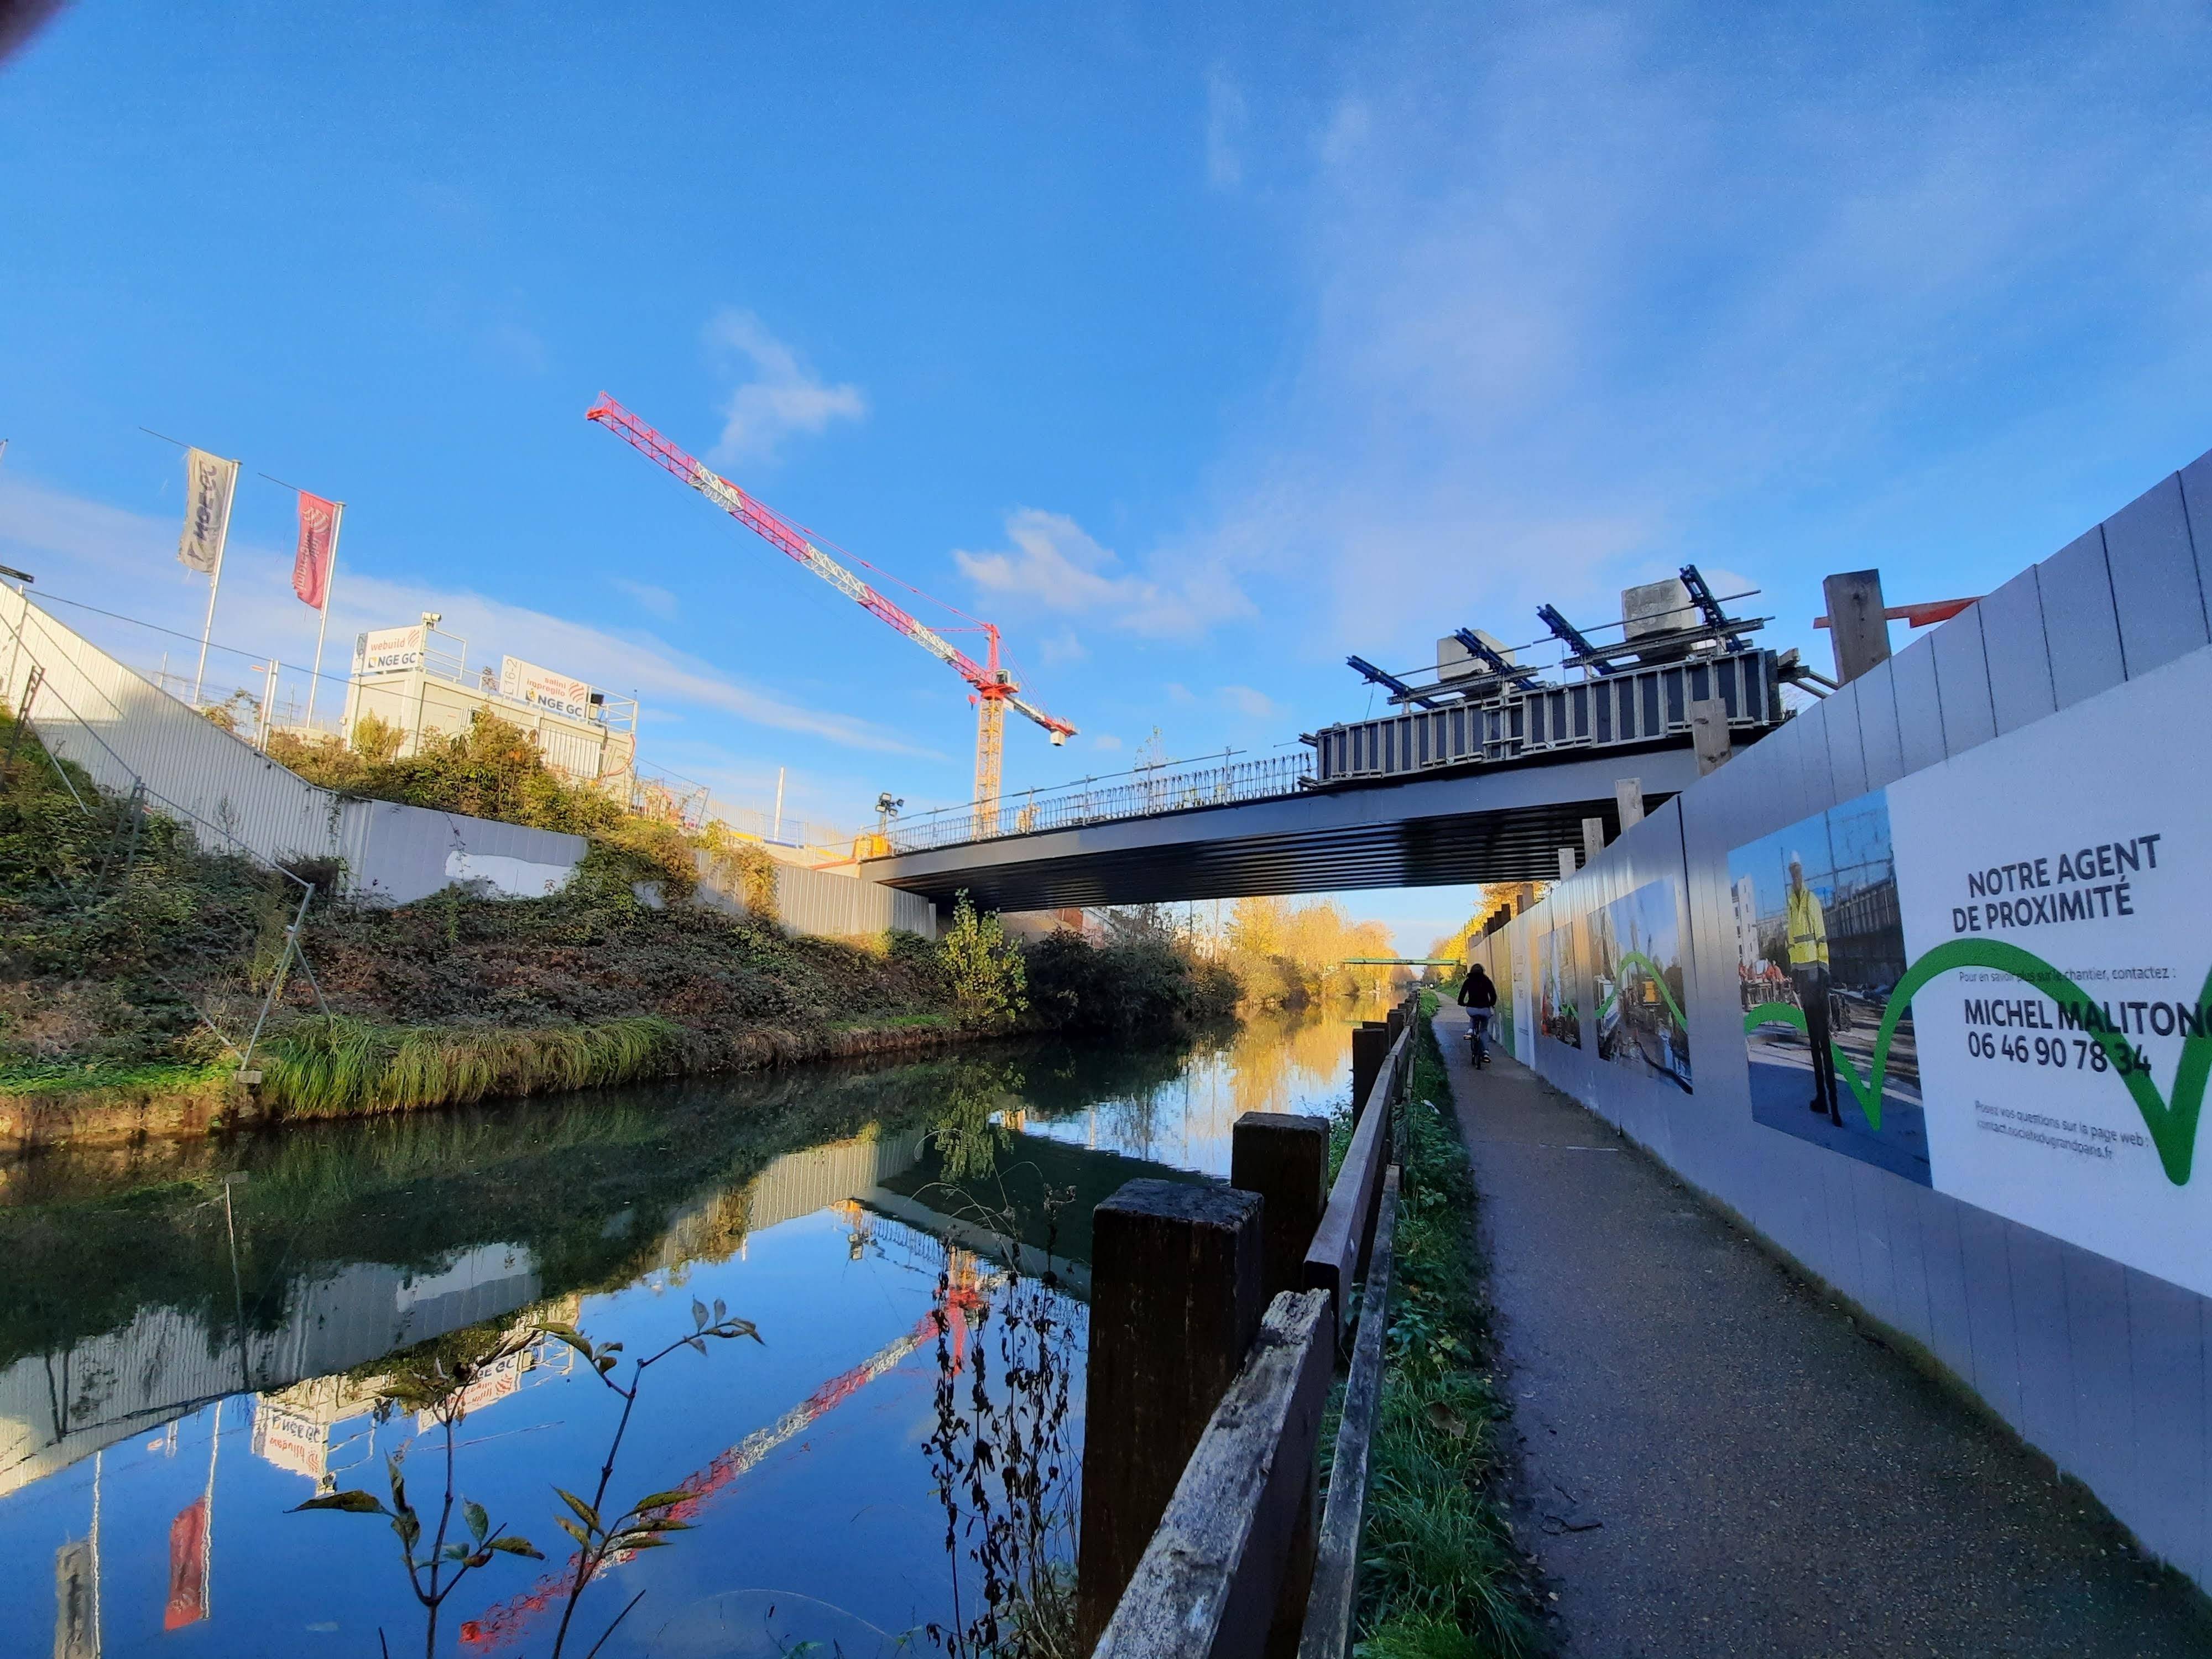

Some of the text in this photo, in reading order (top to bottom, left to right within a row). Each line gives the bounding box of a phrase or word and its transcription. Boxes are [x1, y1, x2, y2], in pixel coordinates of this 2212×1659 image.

[371, 638, 405, 651] webuild
[378, 652, 416, 667] NGE GC
[504, 659, 518, 696] L16-2
[526, 677, 566, 697] impregilo
[545, 677, 566, 689] salini
[538, 695, 583, 717] NGE GC
[1968, 833, 2161, 898] NOTRE AGENT
[1952, 875, 2133, 933] DE PROXIMITÉ
[1959, 972, 1976, 982] Pour
[1980, 973, 1989, 982] en
[1991, 972, 2015, 982] savoir
[2064, 967, 2109, 981] chantier,
[2111, 967, 2170, 979] contactez
[1964, 999, 2052, 1029] MICHEL
[1968, 1031, 2151, 1077] 06 46 90 78 34
[2001, 1108, 2015, 1119] vos
[2017, 1111, 2060, 1129] questions
[2062, 1120, 2077, 1132] sur
[2090, 1126, 2117, 1142] page
[2120, 1131, 2143, 1146] web
